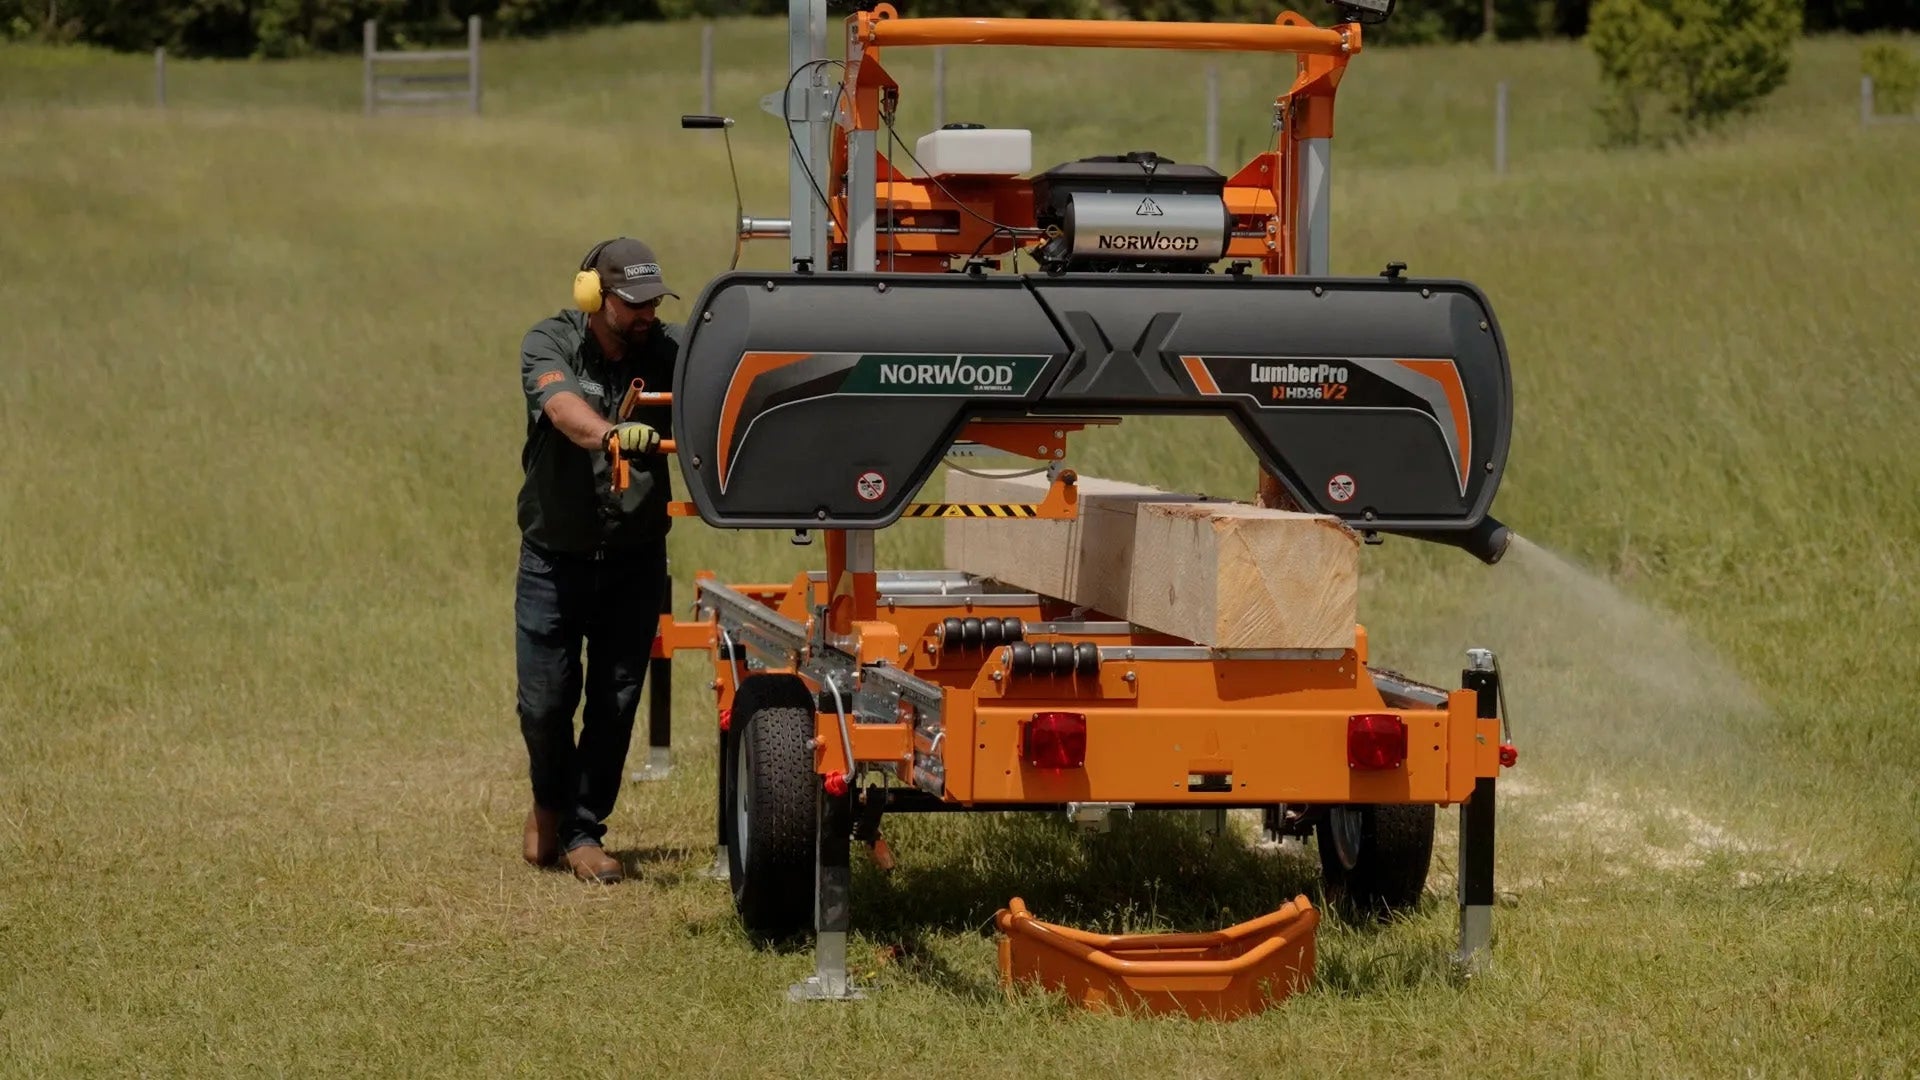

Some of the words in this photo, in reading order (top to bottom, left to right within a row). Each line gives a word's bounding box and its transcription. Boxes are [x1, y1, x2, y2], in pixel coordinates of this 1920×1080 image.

[1099, 231, 1199, 251] NORWOOD
[627, 265, 660, 277] NORWO
[880, 356, 1013, 385] NORWOOD
[1251, 363, 1348, 384] LumberPro
